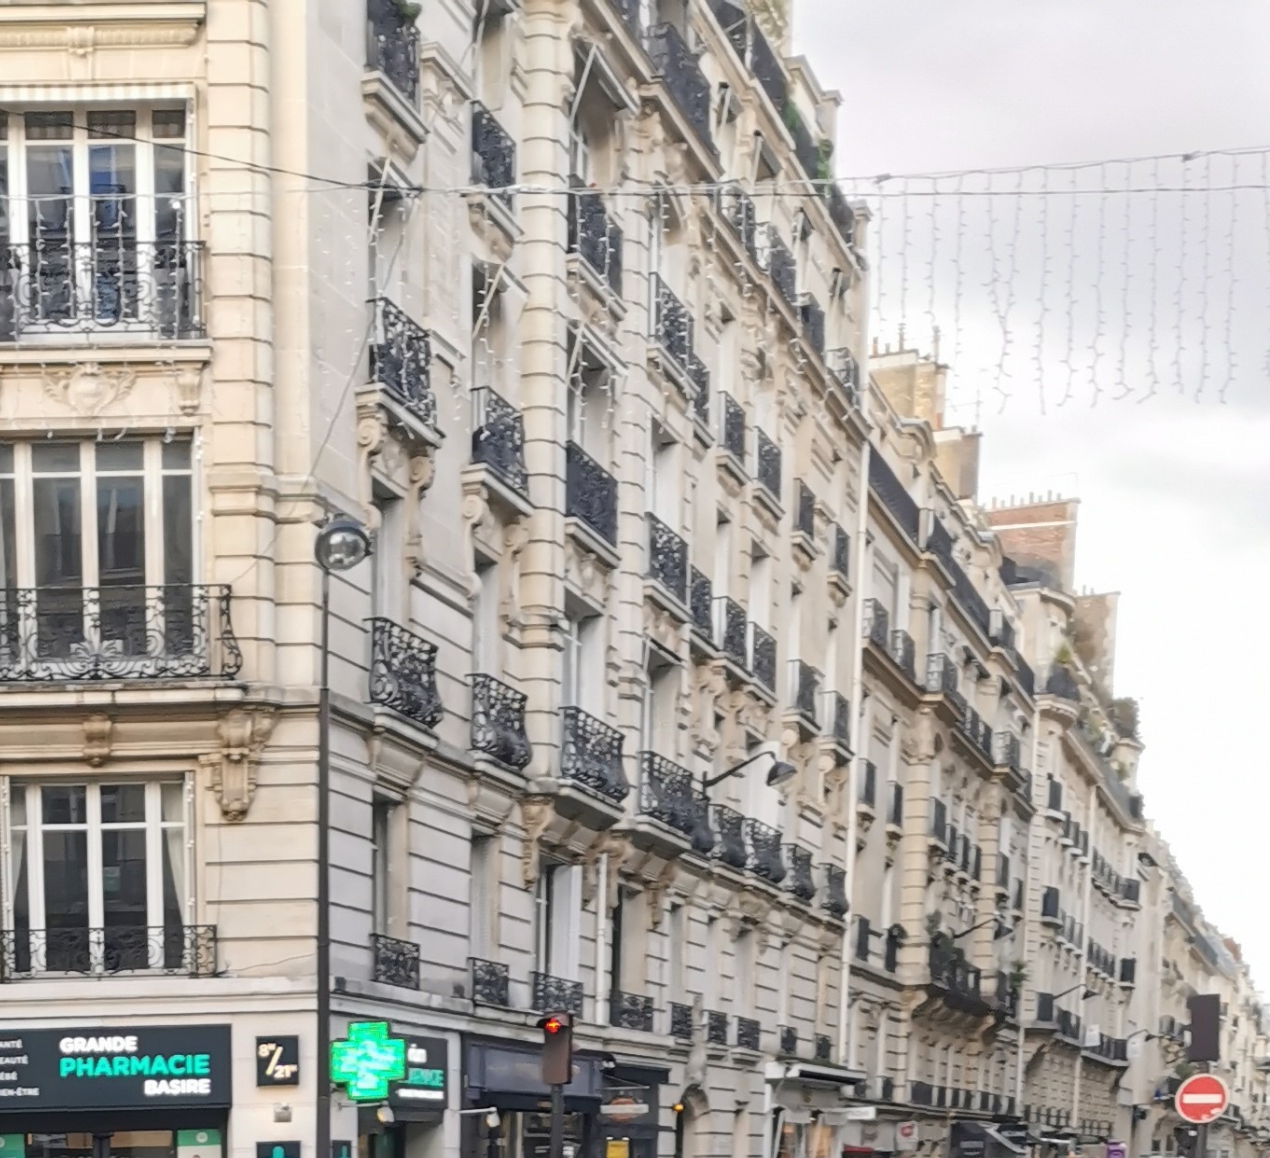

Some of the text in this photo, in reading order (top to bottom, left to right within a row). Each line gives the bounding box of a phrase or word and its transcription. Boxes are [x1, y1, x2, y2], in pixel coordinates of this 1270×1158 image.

[59, 1036, 138, 1054] GRANDE
[59, 1054, 211, 1077] PHARMACIE
[144, 1078, 212, 1096] BASIRE
